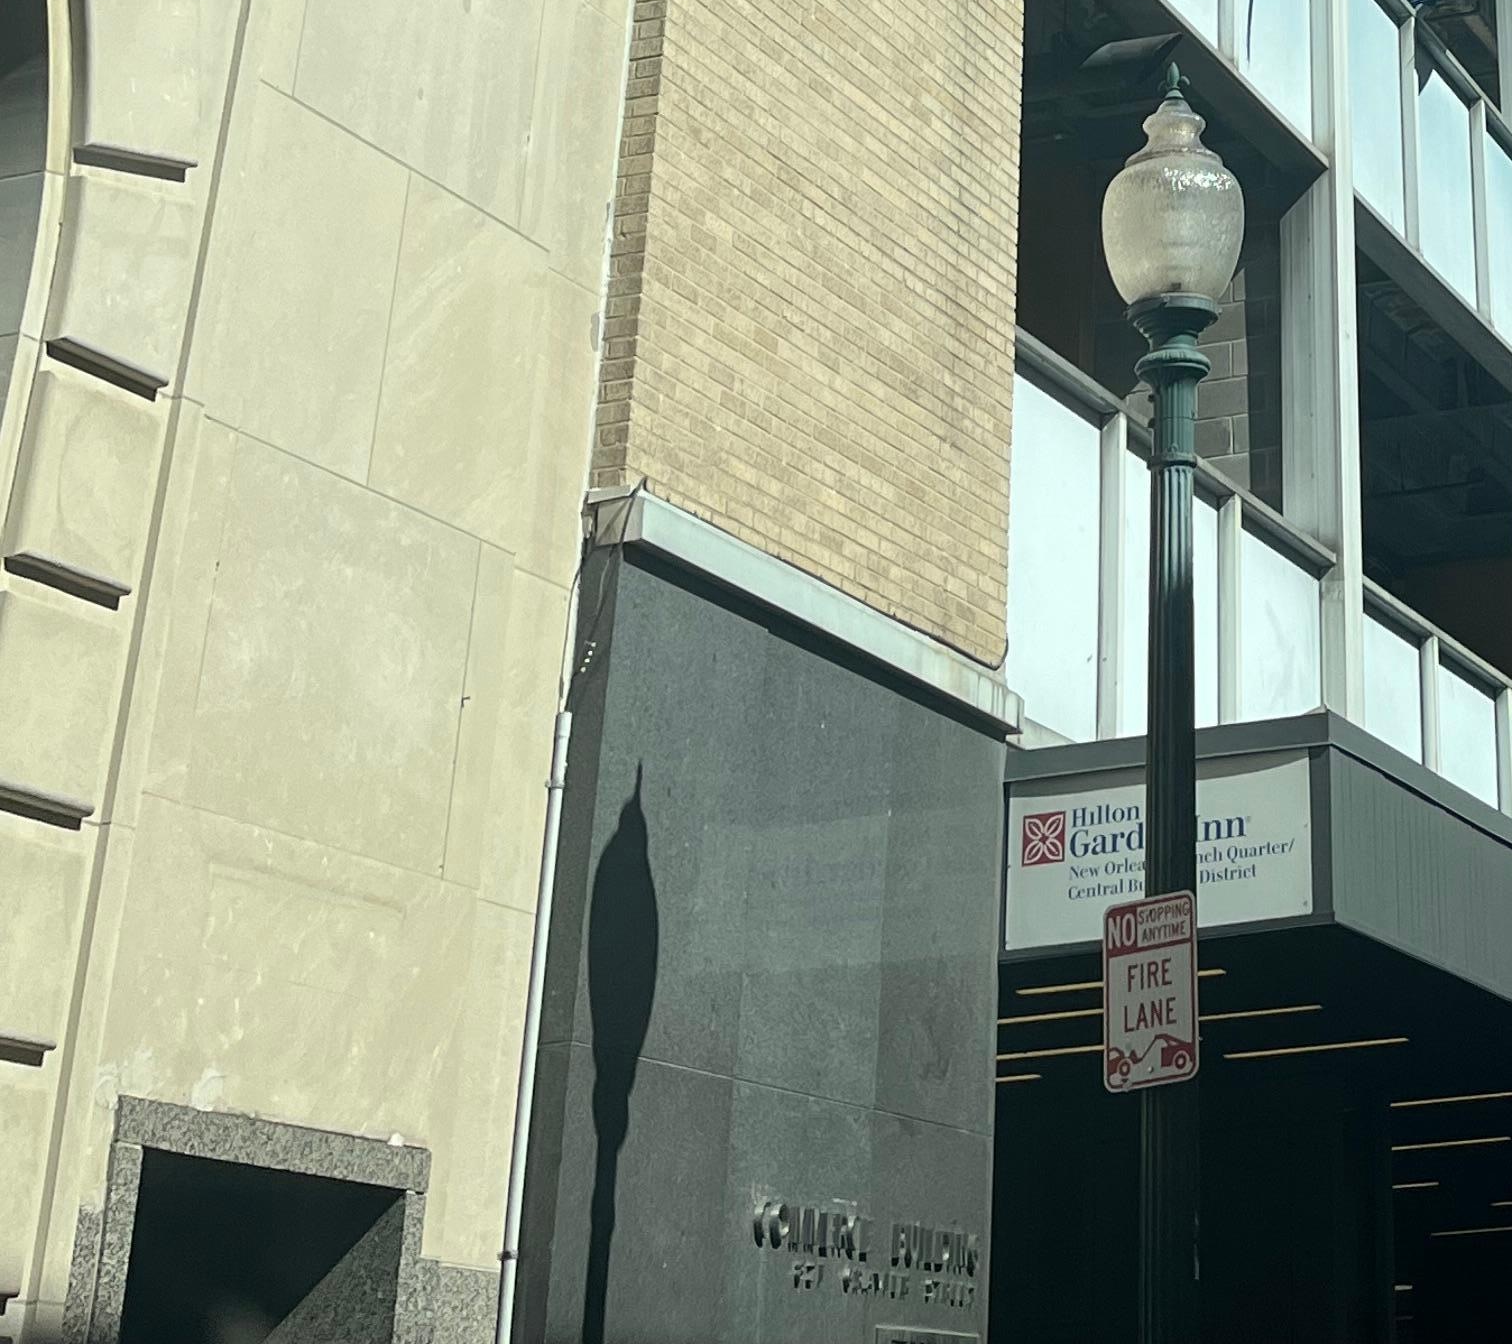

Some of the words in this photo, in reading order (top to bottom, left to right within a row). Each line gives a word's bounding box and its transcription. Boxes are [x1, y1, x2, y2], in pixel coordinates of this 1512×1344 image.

[1071, 804, 1140, 828] Hilton
[1069, 822, 1144, 859] Gard
[1069, 864, 1099, 880] New
[1104, 858, 1145, 875] Orlea
[1226, 838, 1295, 862] Quarter/
[1068, 880, 1123, 900] Central
[1200, 864, 1256, 884] District
[1107, 912, 1136, 950] NO
[1141, 920, 1187, 943] ANYTIME
[1127, 957, 1173, 993] FIRE
[1124, 996, 1178, 1033] LANE
